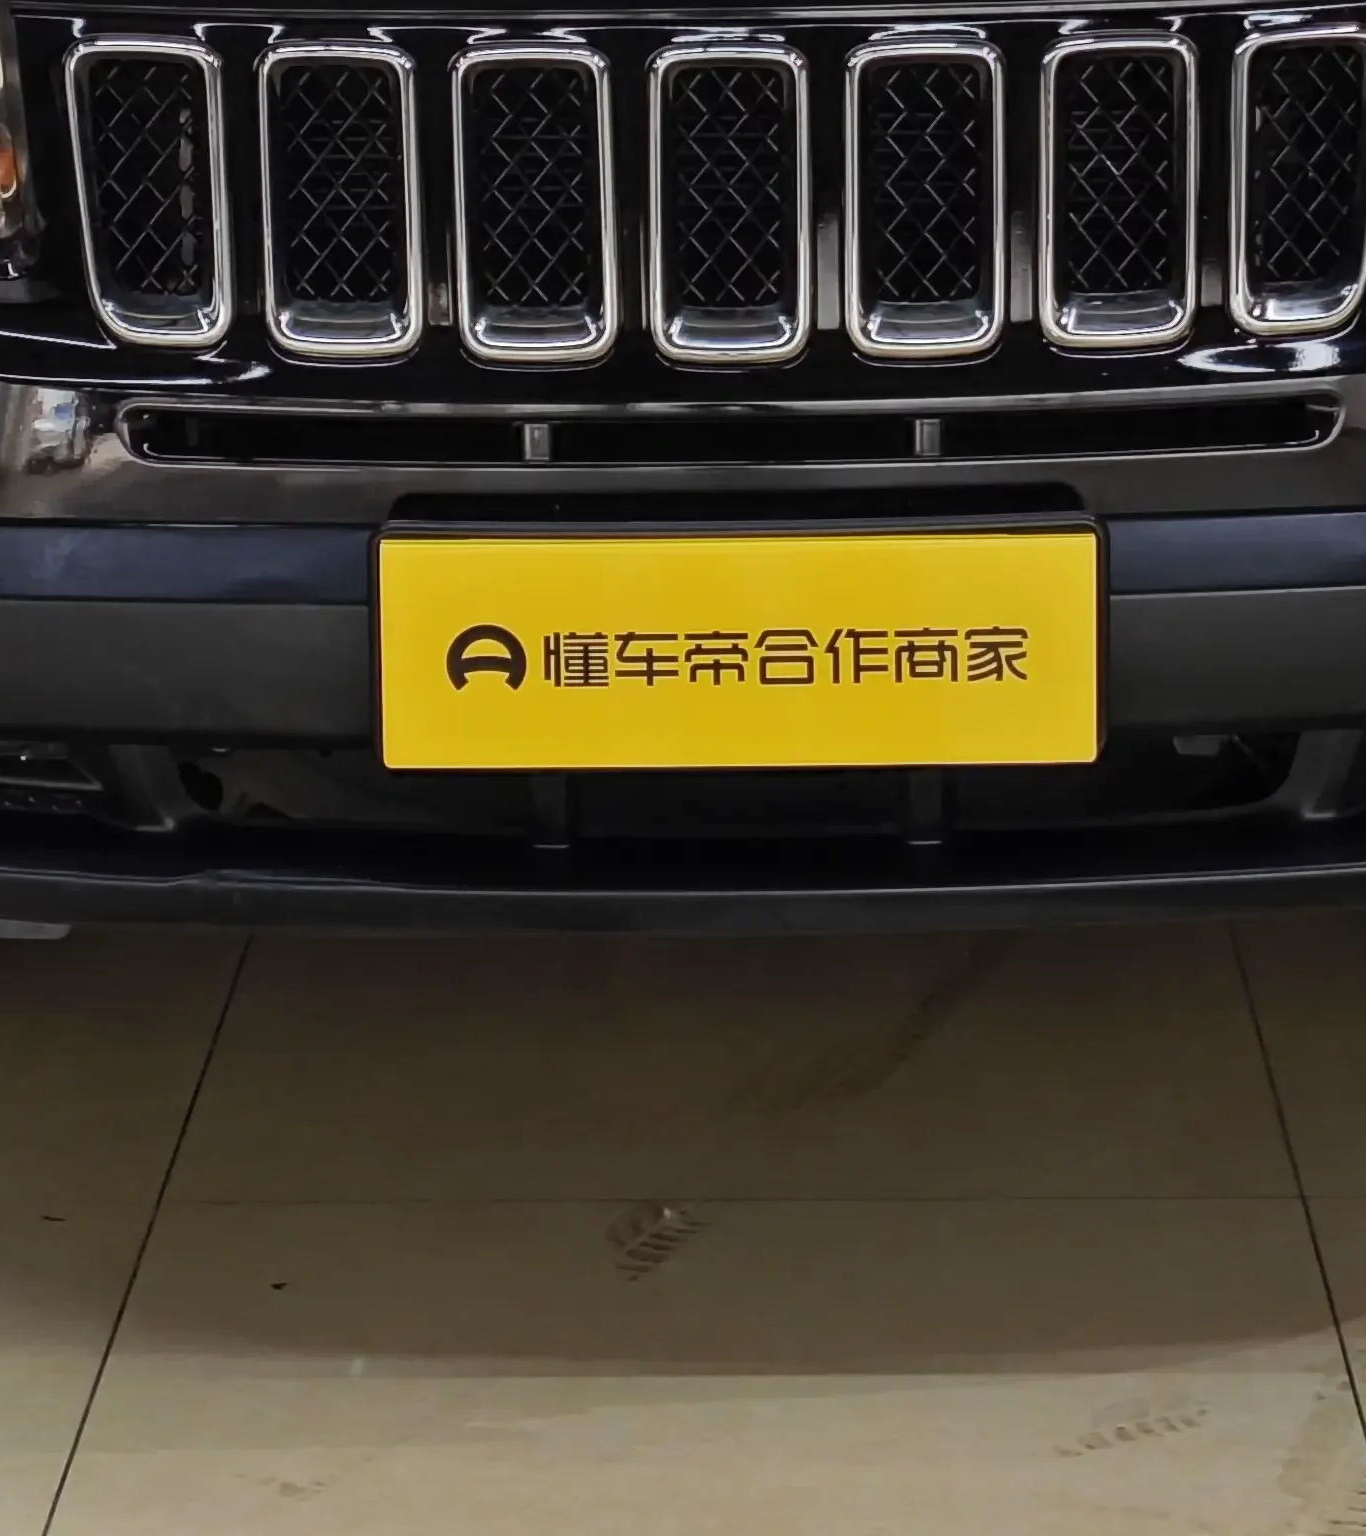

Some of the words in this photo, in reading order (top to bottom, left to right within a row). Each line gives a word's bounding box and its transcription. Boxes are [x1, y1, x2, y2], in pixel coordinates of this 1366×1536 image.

[543, 625, 1029, 688] 懂车帝合作商家
